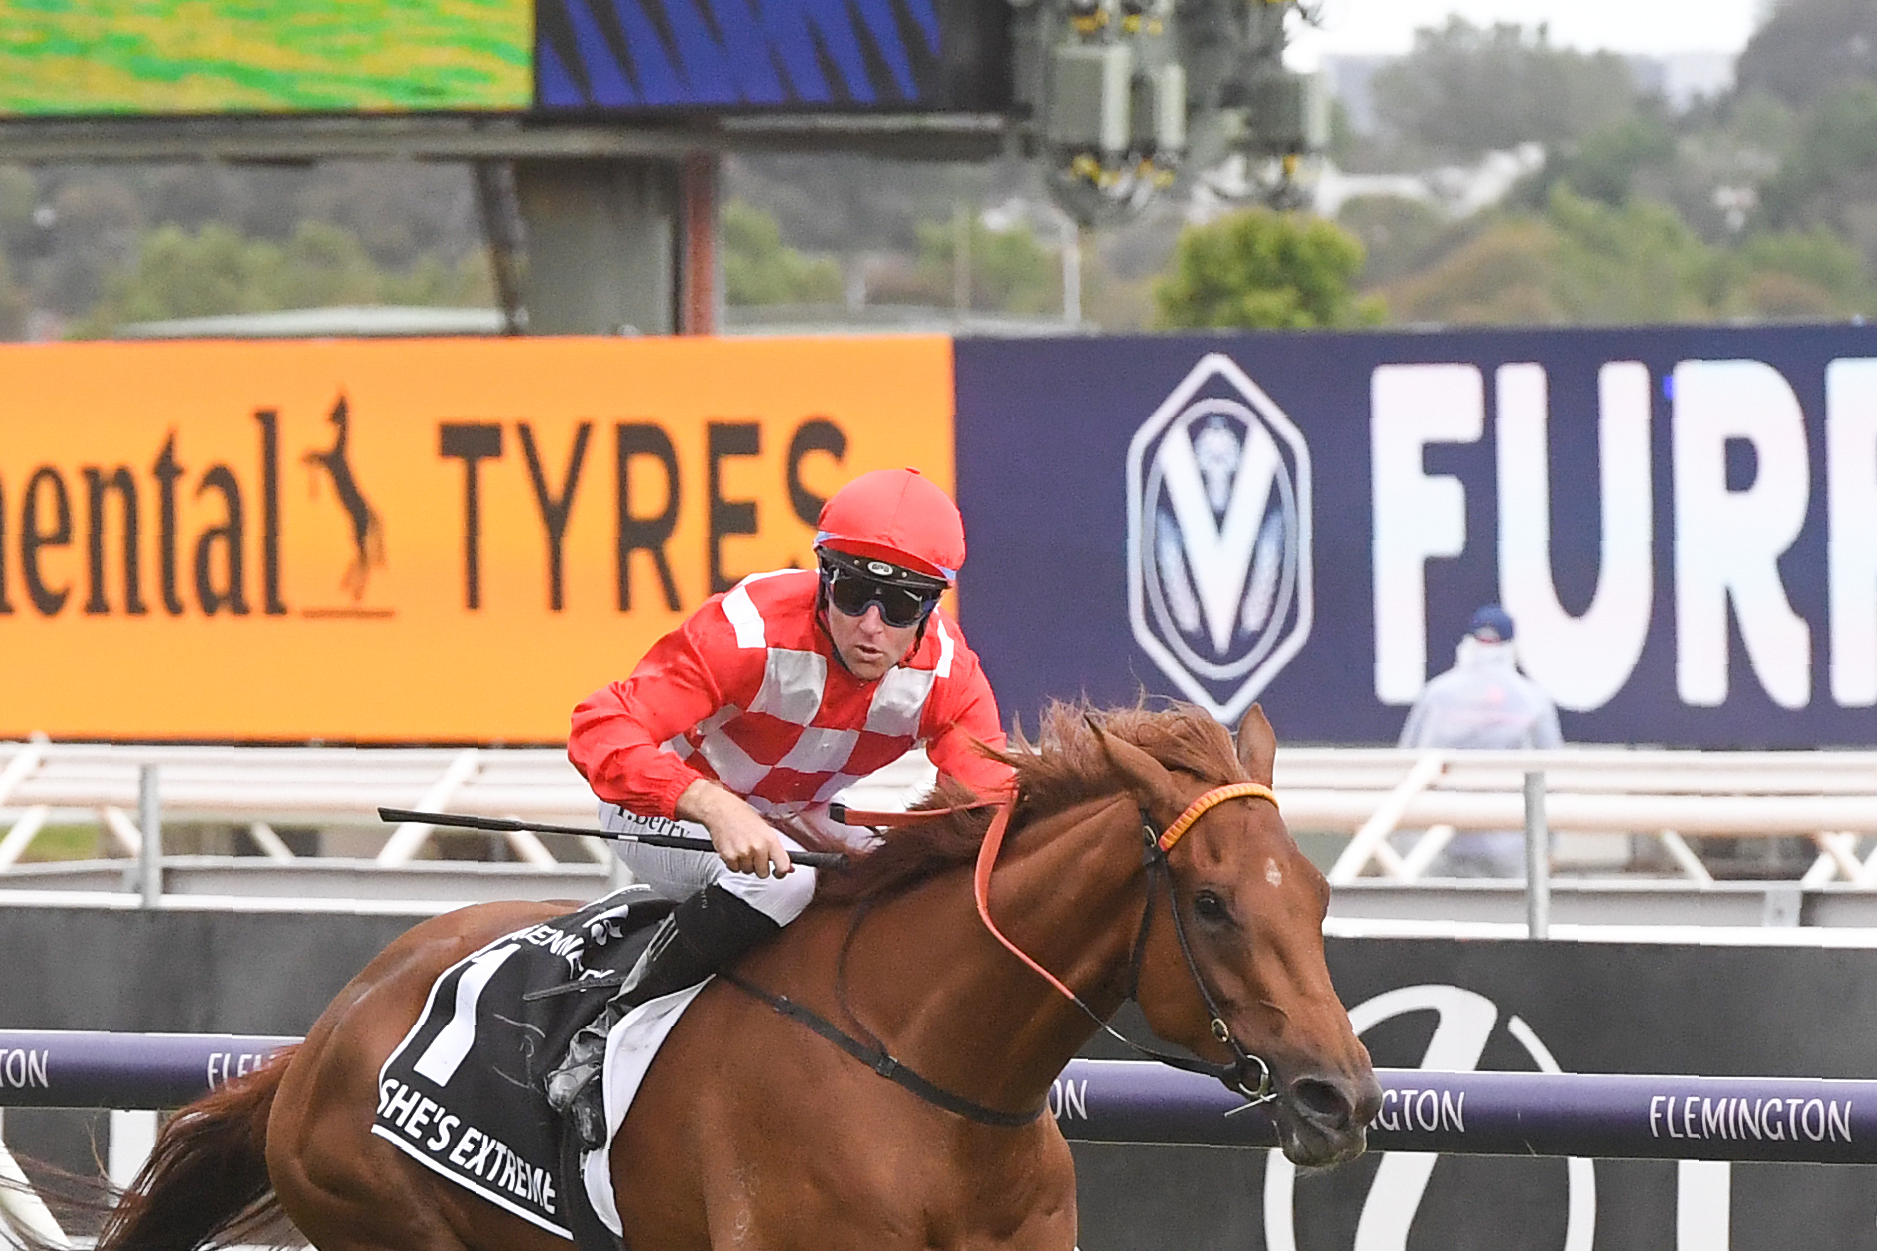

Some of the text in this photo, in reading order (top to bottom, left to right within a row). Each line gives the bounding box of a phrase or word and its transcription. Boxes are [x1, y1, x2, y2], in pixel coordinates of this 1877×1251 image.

[439, 420, 849, 612] TYRES
[377, 1079, 556, 1214] SHE'S EXTREME
[1649, 1095, 1852, 1142] FLEMINGTON
